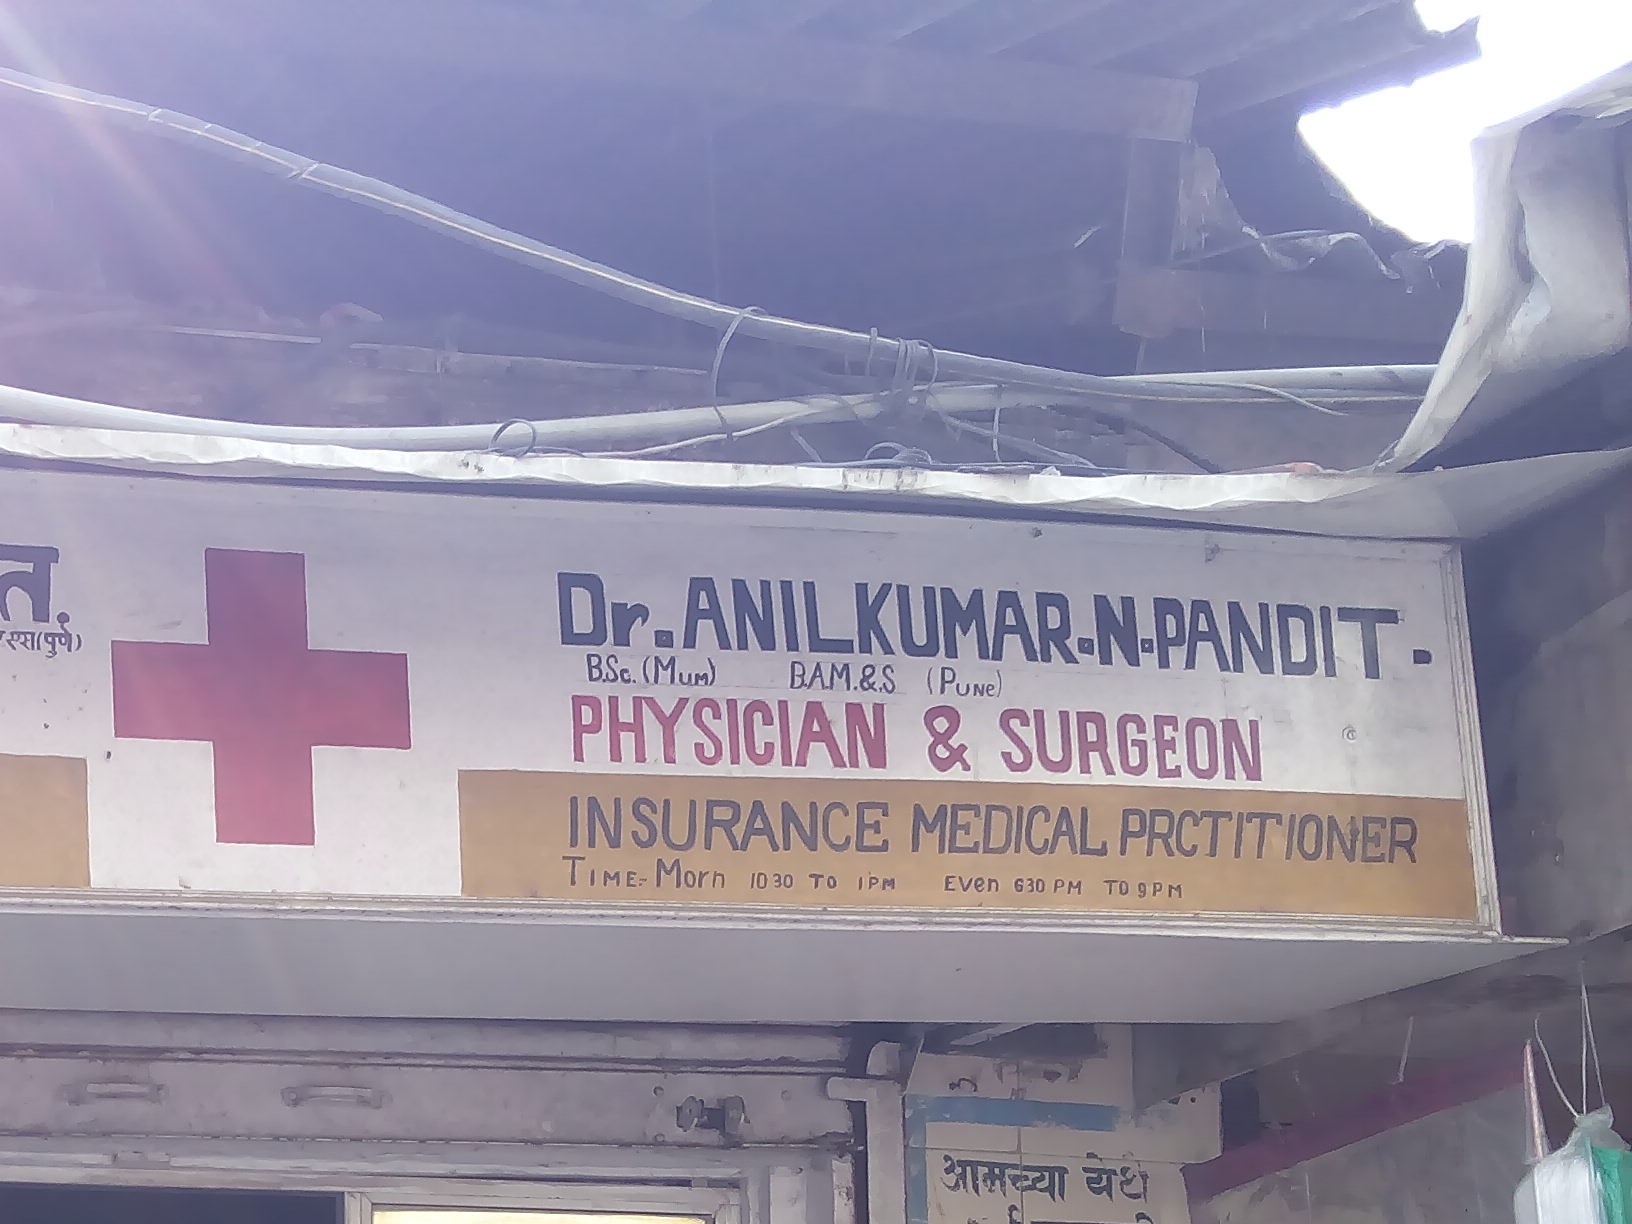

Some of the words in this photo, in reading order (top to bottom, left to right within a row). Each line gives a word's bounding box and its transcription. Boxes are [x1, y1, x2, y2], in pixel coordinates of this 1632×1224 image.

[571, 695, 887, 769] PHYSICIAN
[923, 705, 971, 772] &
[999, 708, 1263, 781] SURGEON
[569, 796, 889, 853] INSURANCE
[911, 803, 1108, 858] MEDICAL
[1120, 807, 1418, 865] PRCTITIONER
[940, 1154, 1068, 1203] आमच्या
